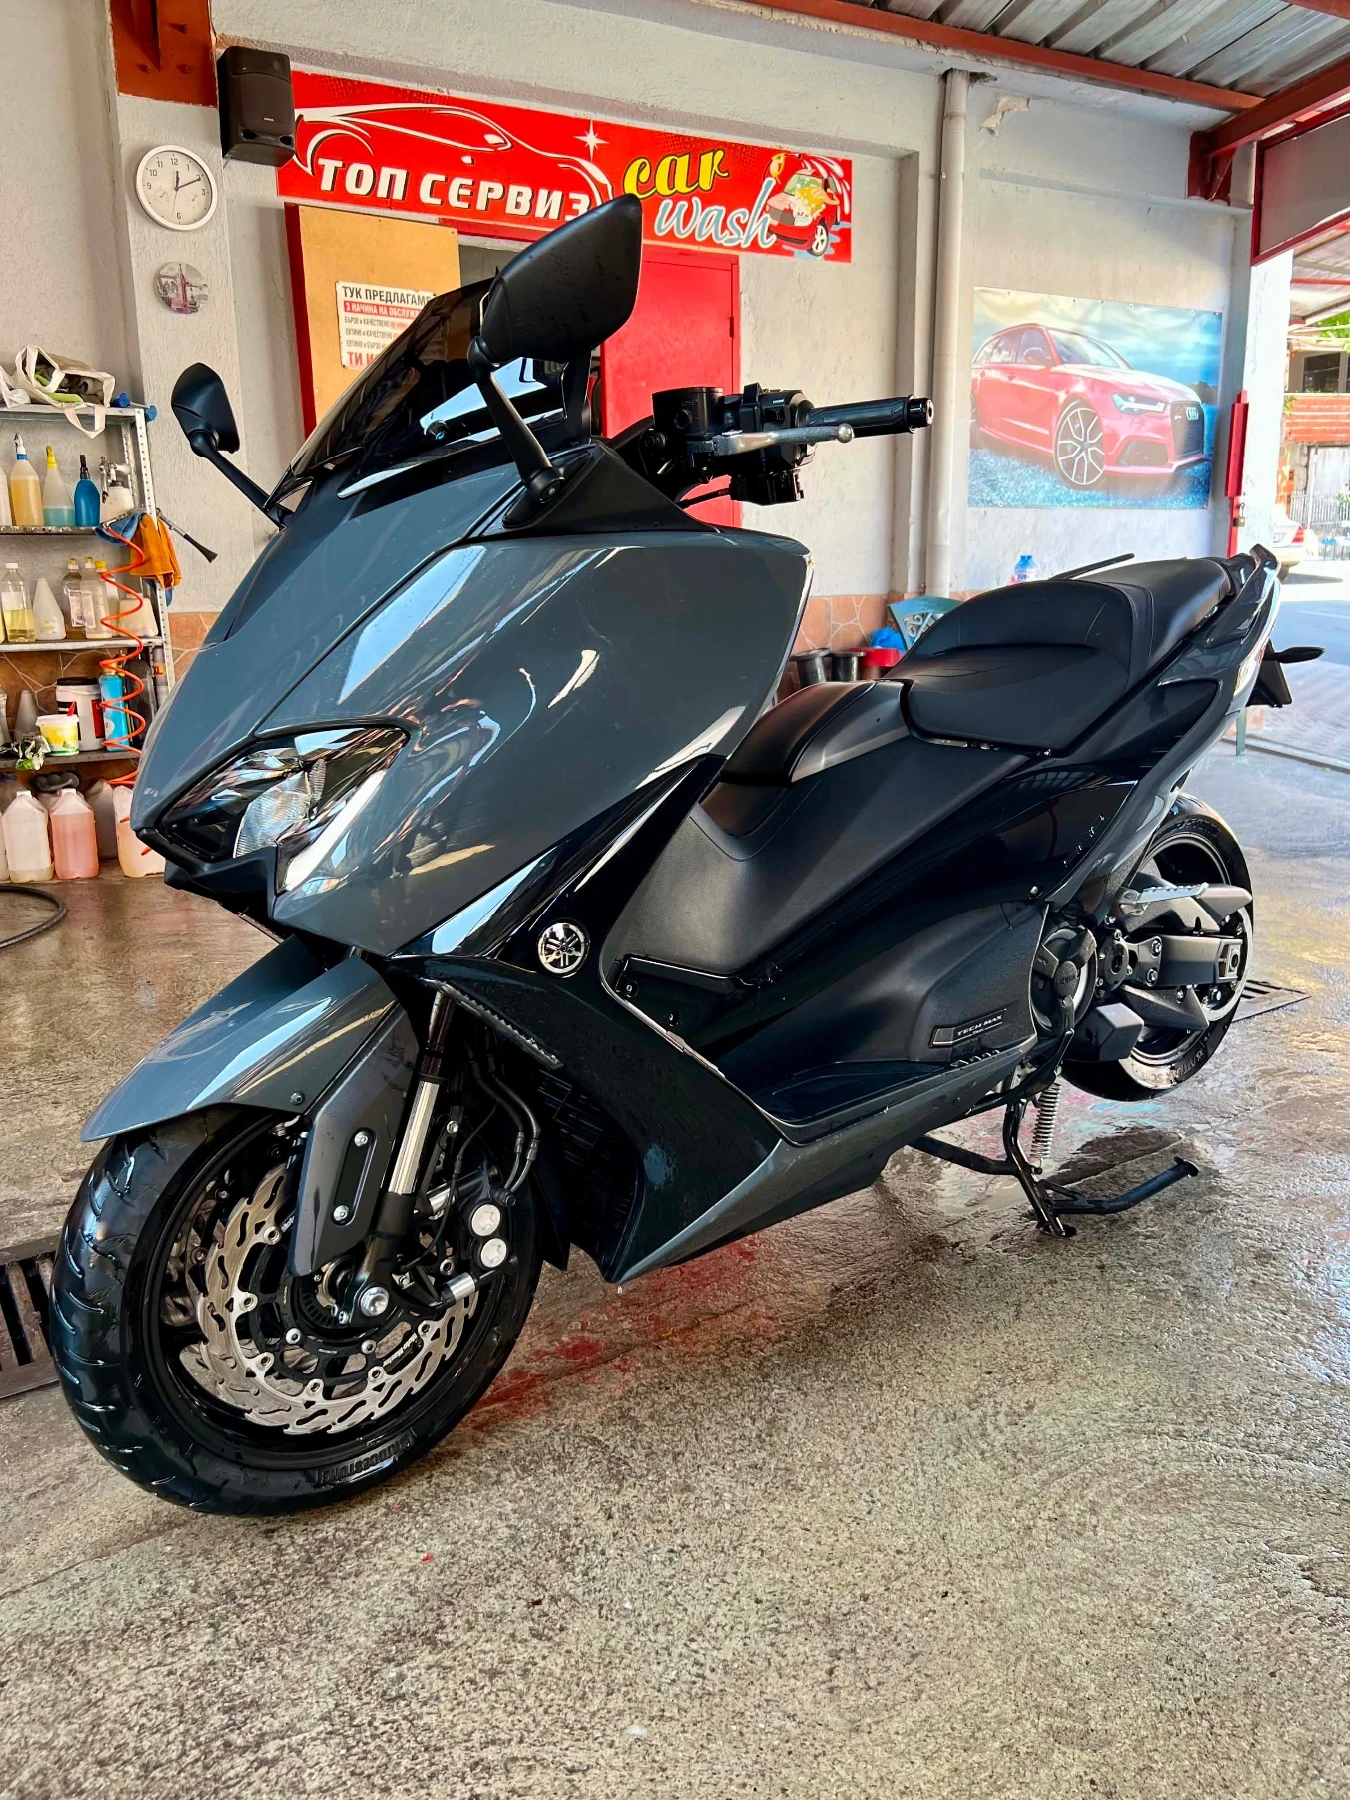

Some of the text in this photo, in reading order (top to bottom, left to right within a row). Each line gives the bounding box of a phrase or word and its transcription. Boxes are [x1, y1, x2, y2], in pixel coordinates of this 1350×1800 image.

[171, 158, 179, 166] 12
[149, 169, 158, 177] 10
[624, 149, 729, 199] car
[146, 182, 152, 190] 9
[201, 188, 206, 196] 3
[318, 158, 593, 222] ТОП СЕРВИЗ
[654, 197, 777, 249] wash
[342, 286, 362, 299] ТУК
[351, 303, 378, 315] НАЧИНА
[379, 306, 388, 316] НА
[347, 351, 363, 366] ТИ
[957, 1023, 982, 1036] TECH
[983, 1015, 1002, 1026] MAX
